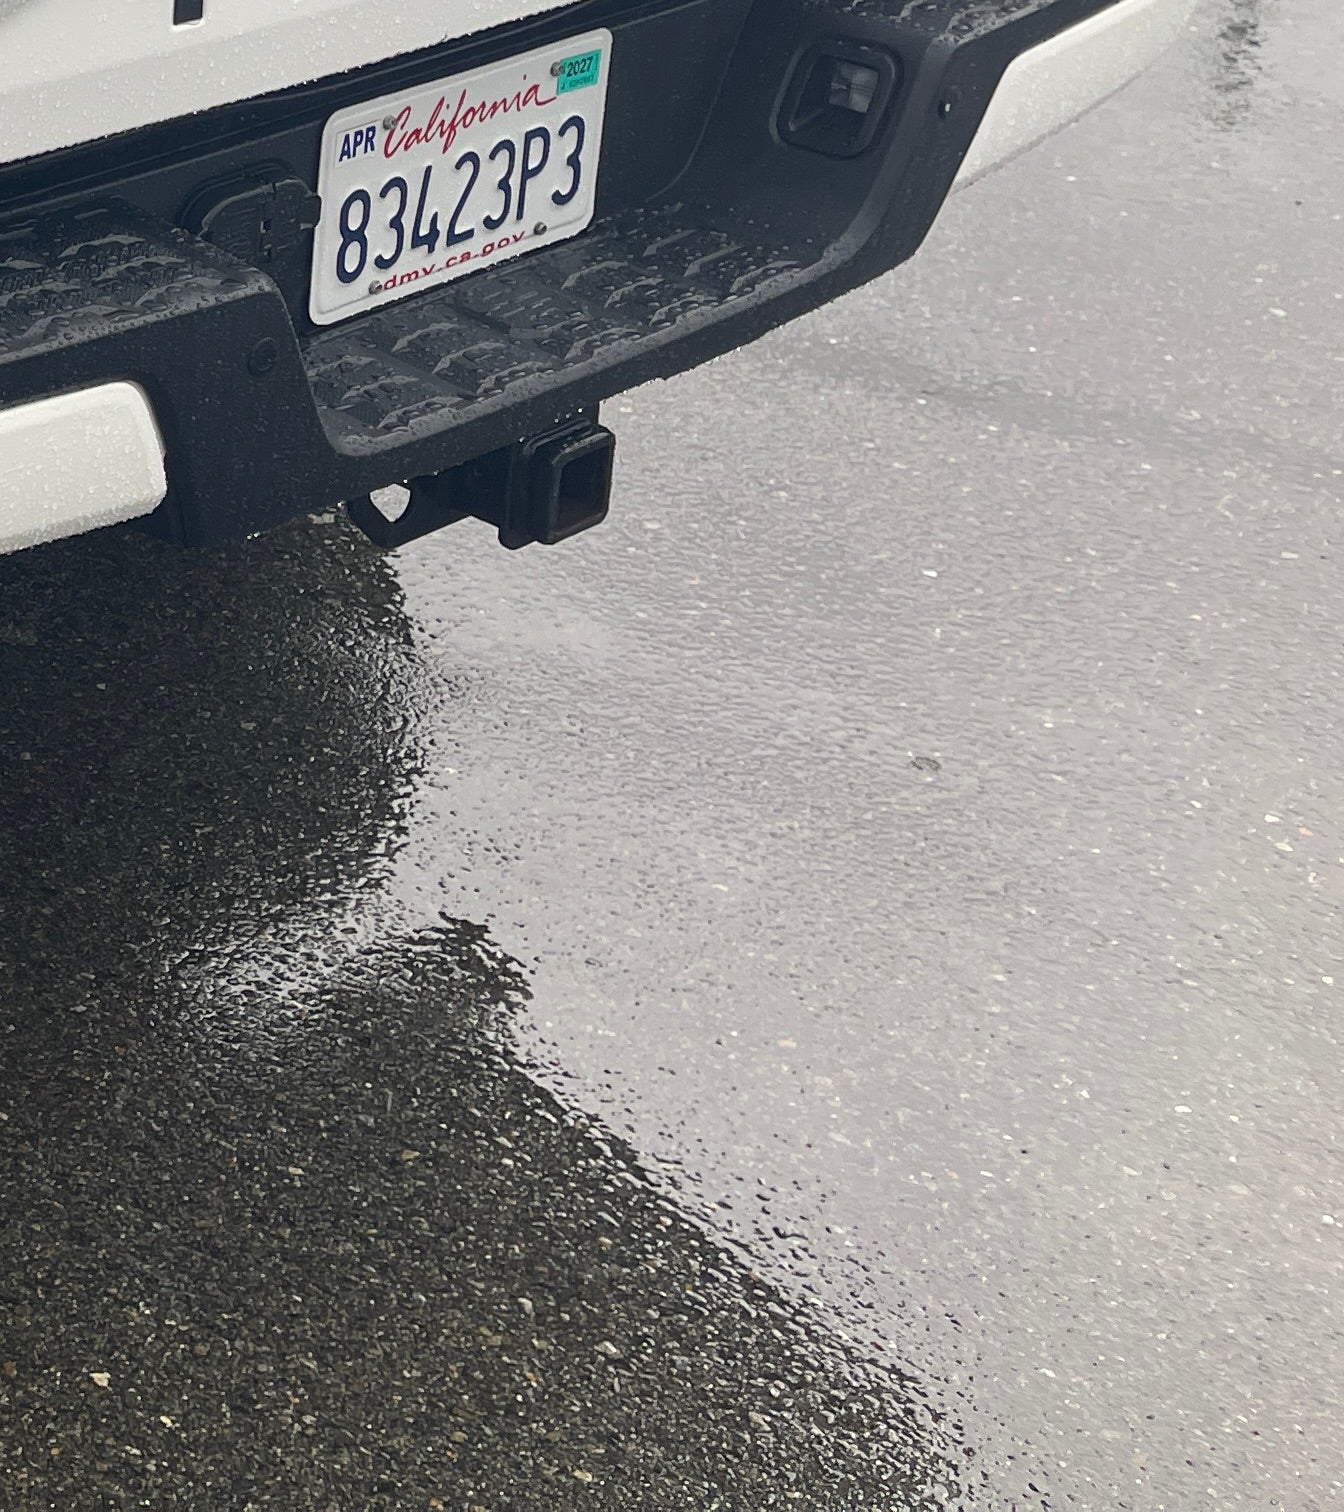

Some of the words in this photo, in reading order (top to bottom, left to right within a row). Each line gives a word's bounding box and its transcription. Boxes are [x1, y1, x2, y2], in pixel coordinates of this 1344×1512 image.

[566, 55, 594, 78] 2027
[338, 125, 377, 162] APR
[383, 75, 558, 159] California
[335, 114, 586, 284] 83423P3
[381, 230, 526, 292] dmv.ca.gov
